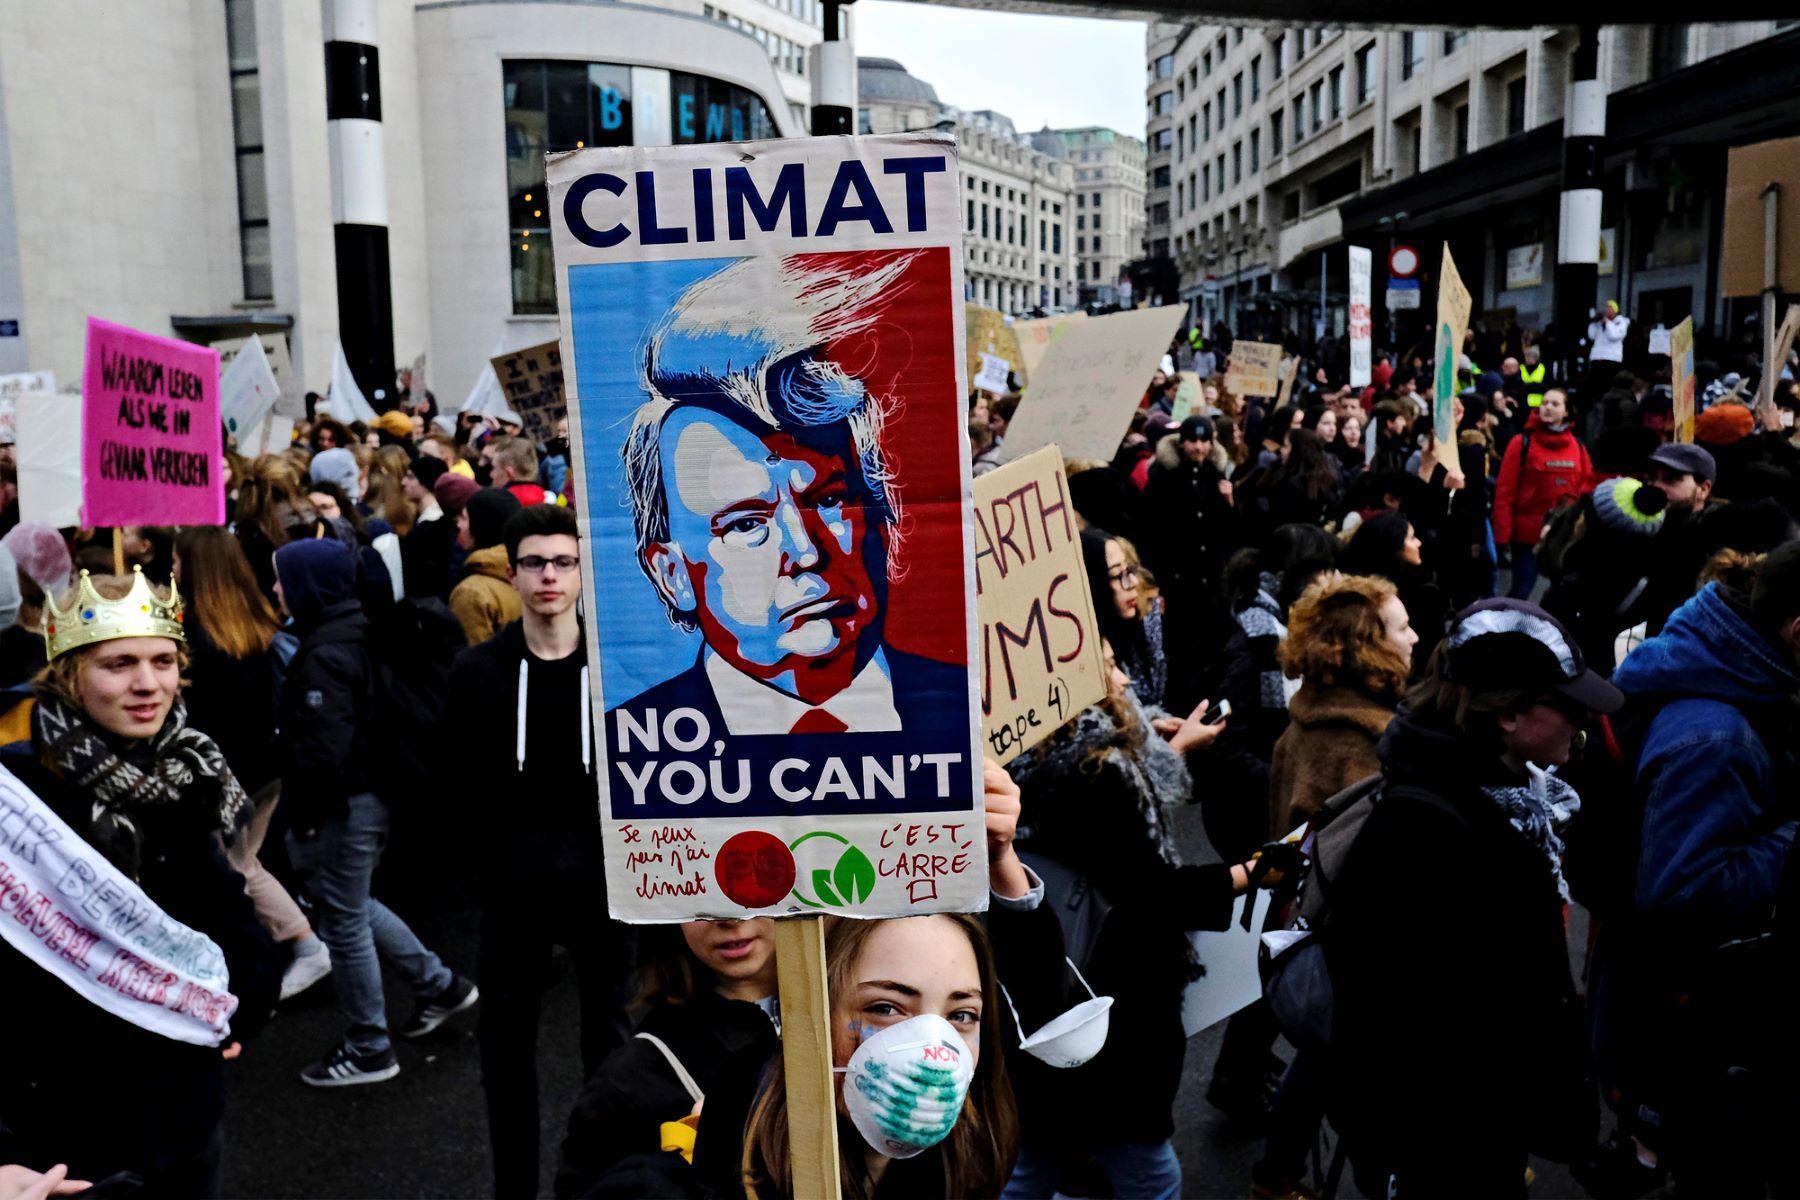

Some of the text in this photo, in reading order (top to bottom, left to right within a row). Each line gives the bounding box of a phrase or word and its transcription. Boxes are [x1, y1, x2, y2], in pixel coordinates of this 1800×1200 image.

[563, 156, 947, 248] CLIMAT
[101, 345, 164, 395] WAAROM
[117, 396, 145, 428] ALS
[148, 402, 169, 433] WE
[100, 440, 148, 481] GEVAAR
[616, 707, 726, 756] NO,
[616, 753, 962, 805] YOU CAN'T
[617, 823, 698, 850] Je peux
[879, 822, 966, 849] C'EST
[670, 840, 711, 876] j'ai
[878, 839, 973, 878] CARRÉ
[57, 857, 151, 938] BEN
[635, 870, 707, 900] climat
[97, 948, 179, 1006] KEER
